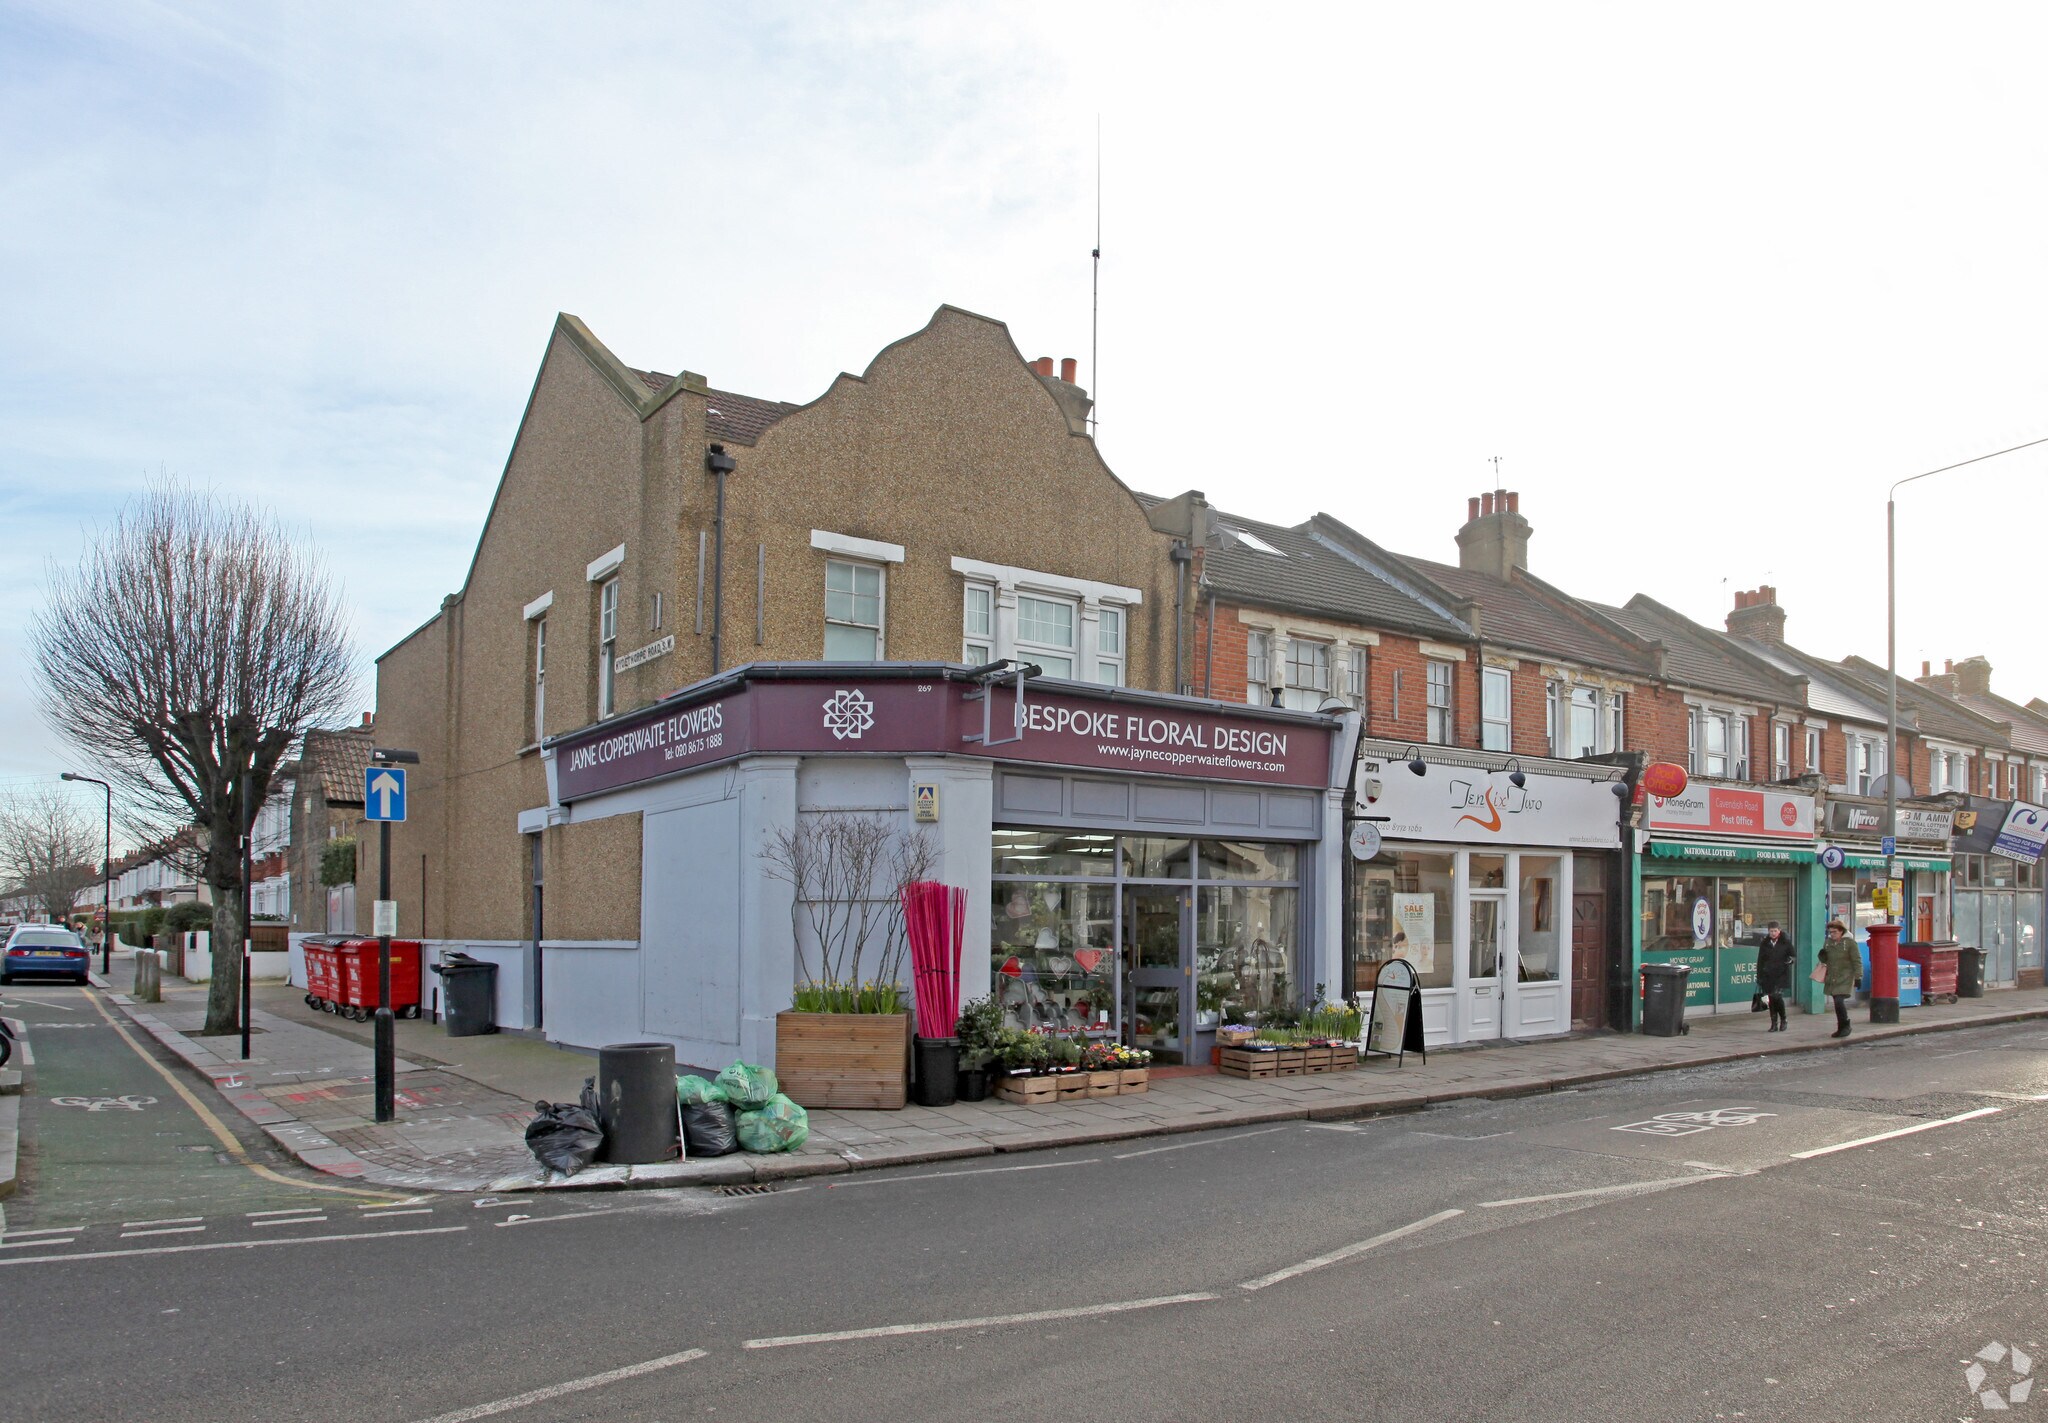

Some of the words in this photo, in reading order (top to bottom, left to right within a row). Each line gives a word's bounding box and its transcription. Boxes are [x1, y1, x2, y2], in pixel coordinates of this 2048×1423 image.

[917, 685, 932, 693] 269
[1014, 702, 1120, 740] BESPOKE
[1126, 716, 1208, 749] FLORAL
[1214, 726, 1288, 757] DESIGN
[570, 744, 597, 772] JAYNE
[598, 721, 666, 764] COPPERWAITE
[668, 702, 724, 743] FLOWERS
[675, 743, 687, 758] 020
[688, 738, 705, 755] 8675
[706, 732, 723, 750] 1888
[1097, 743, 1286, 773] www.jaynecopperwaiteflowers.com
[1365, 762, 1379, 773] 271
[1665, 798, 1704, 810] MoneyGram
[1715, 797, 1744, 810] Cavendish
[1744, 800, 1758, 812] Road
[1721, 814, 1735, 825] Post
[1736, 816, 1754, 827] Office
[1847, 808, 1880, 830] Mirror
[1926, 813, 1950, 824] AMIN
[1919, 831, 1939, 839] LICENCE
[1684, 847, 1711, 856] NATIONAL
[1712, 849, 1737, 857] LOTTERY
[1757, 850, 1771, 859] FOOD
[1993, 846, 2004, 854] 020
[1404, 904, 1424, 913] SALE
[1734, 963, 1746, 973] WE
[1686, 981, 1711, 990] ATIONAL
[1730, 975, 1752, 985] NEWS
